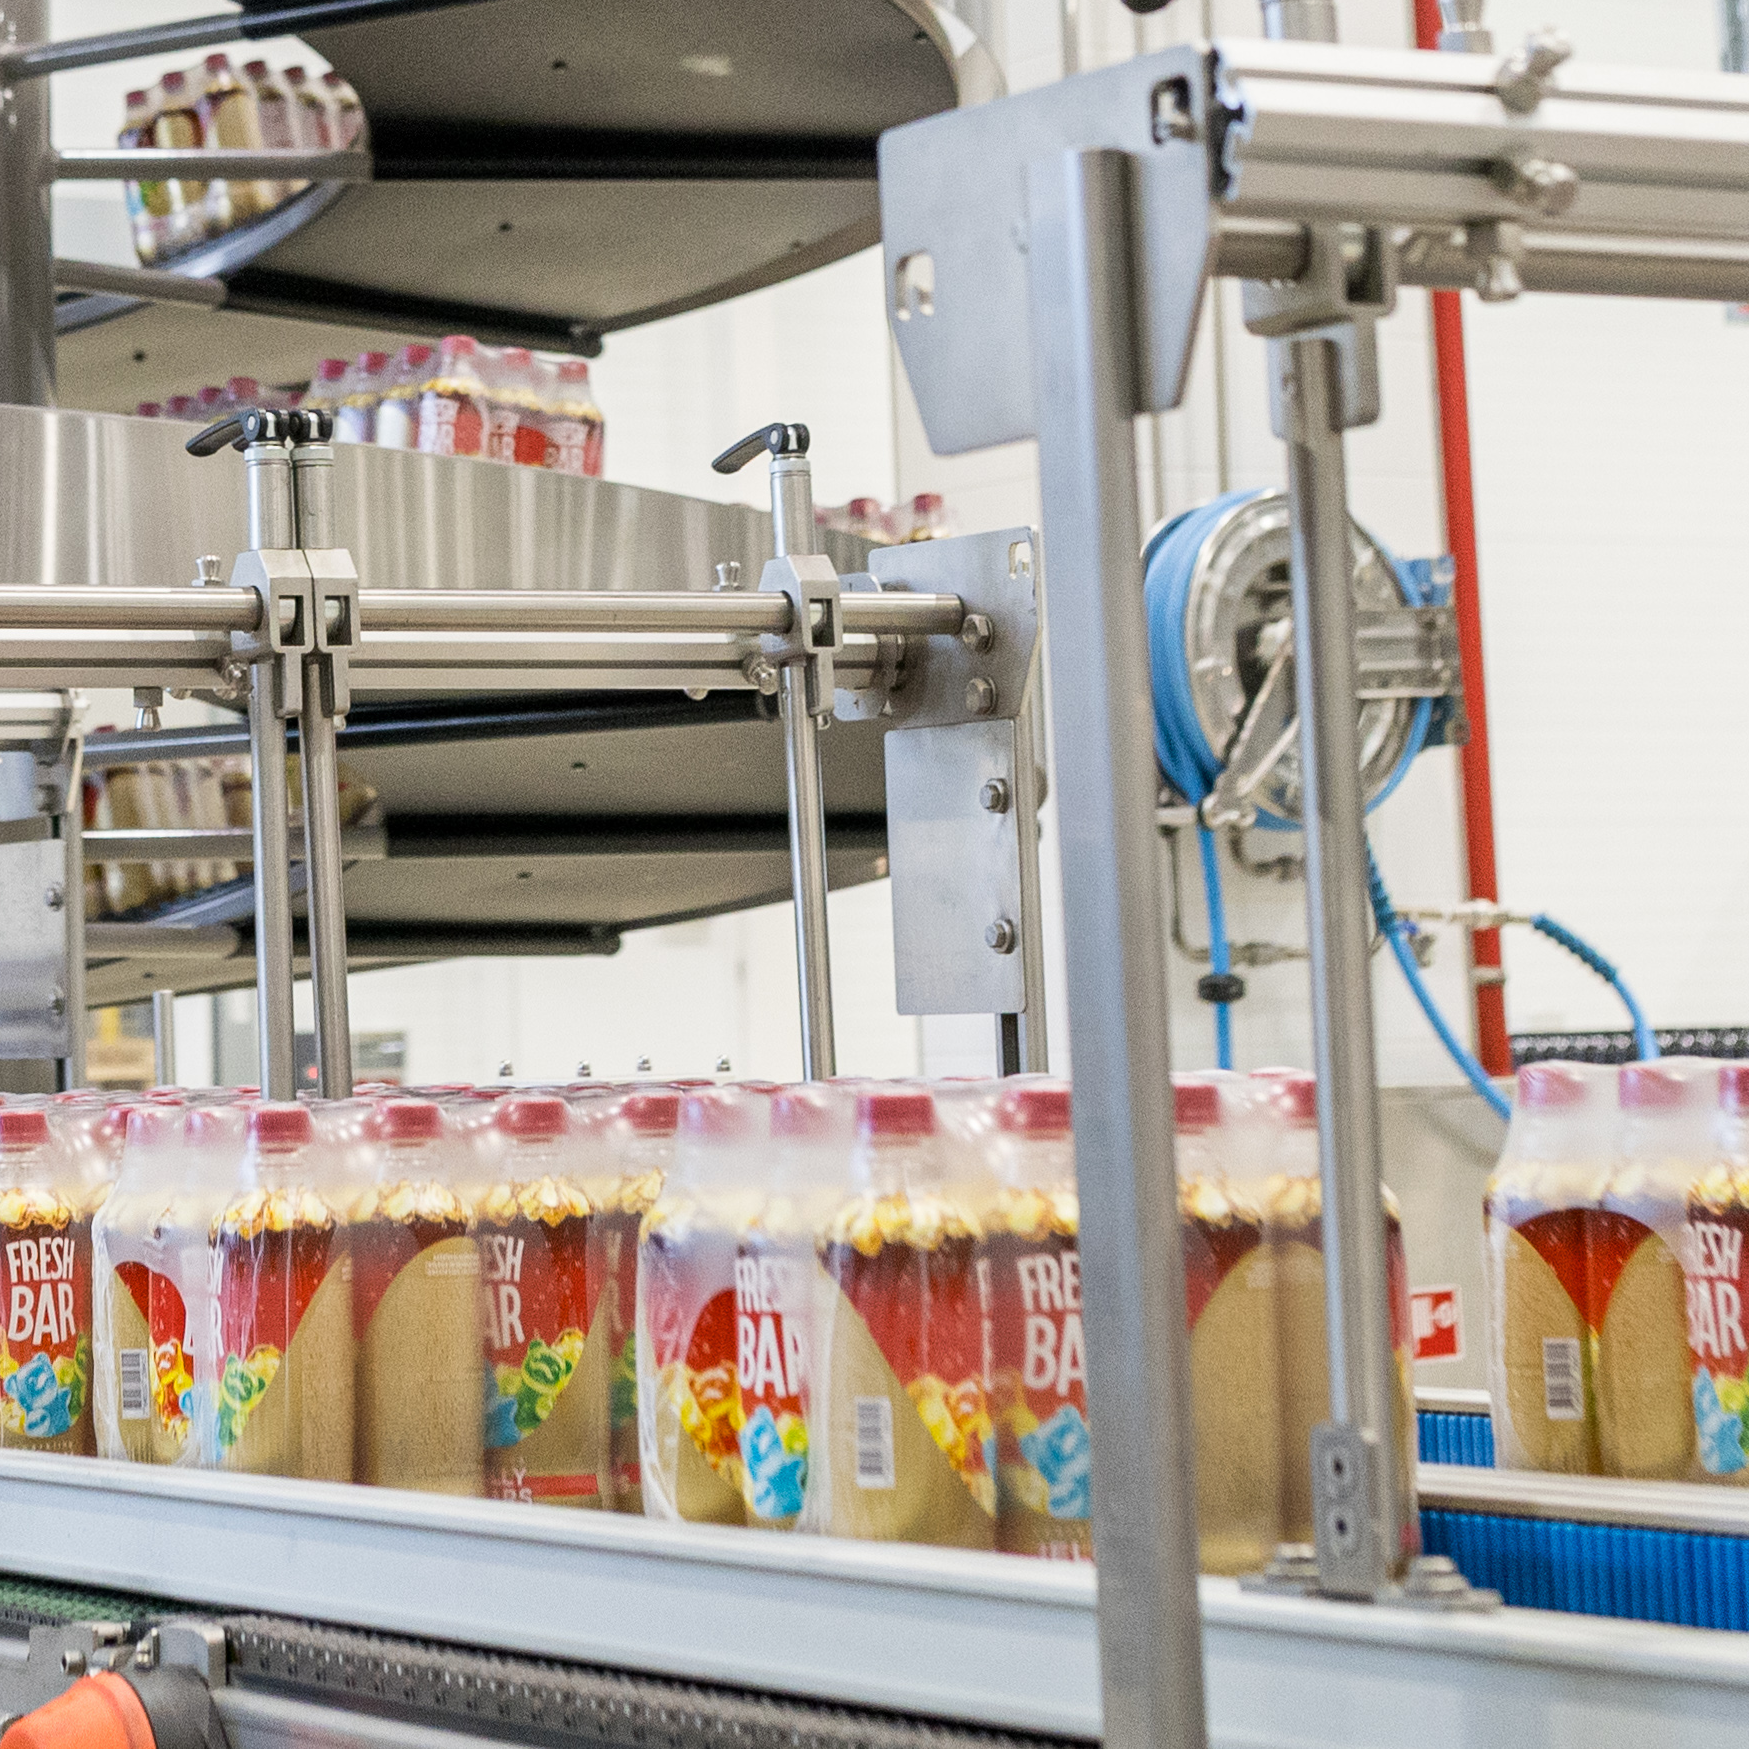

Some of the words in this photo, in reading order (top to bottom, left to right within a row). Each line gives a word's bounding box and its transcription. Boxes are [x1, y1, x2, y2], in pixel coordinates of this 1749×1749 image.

[6, 1237, 76, 1283] FRESH
[1016, 1252, 1083, 1313] FRE
[7, 1282, 77, 1346] BAR
[1023, 1312, 1087, 1398] BA
